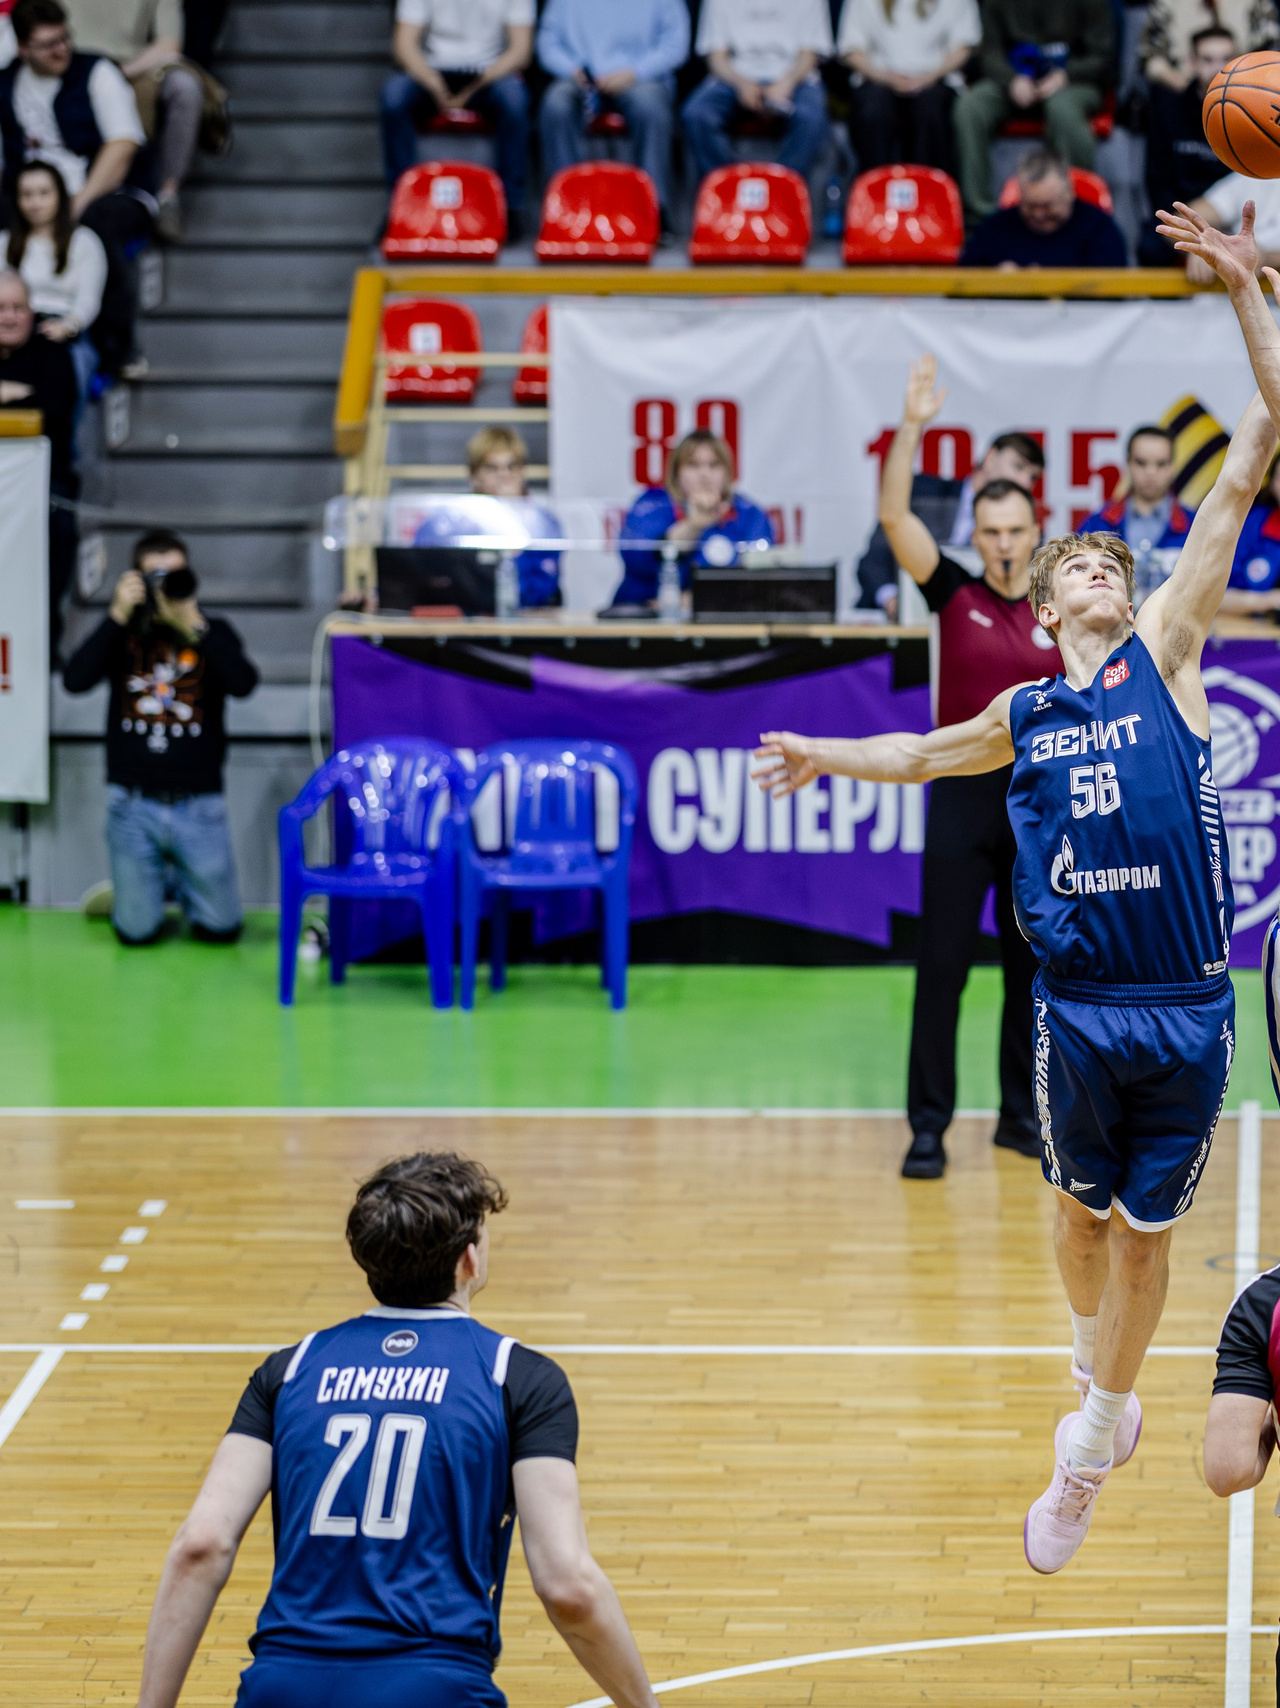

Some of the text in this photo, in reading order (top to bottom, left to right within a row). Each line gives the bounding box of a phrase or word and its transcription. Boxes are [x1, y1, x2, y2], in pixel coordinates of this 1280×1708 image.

[1104, 661, 1125, 678] FON
[1105, 668, 1127, 687] BET
[1033, 702, 1053, 712] KELME
[1031, 714, 1142, 763] ЗЕНИТ
[1070, 762, 1121, 819] 56
[316, 1366, 450, 1404] САМУХИН
[309, 1412, 427, 1540] 20
